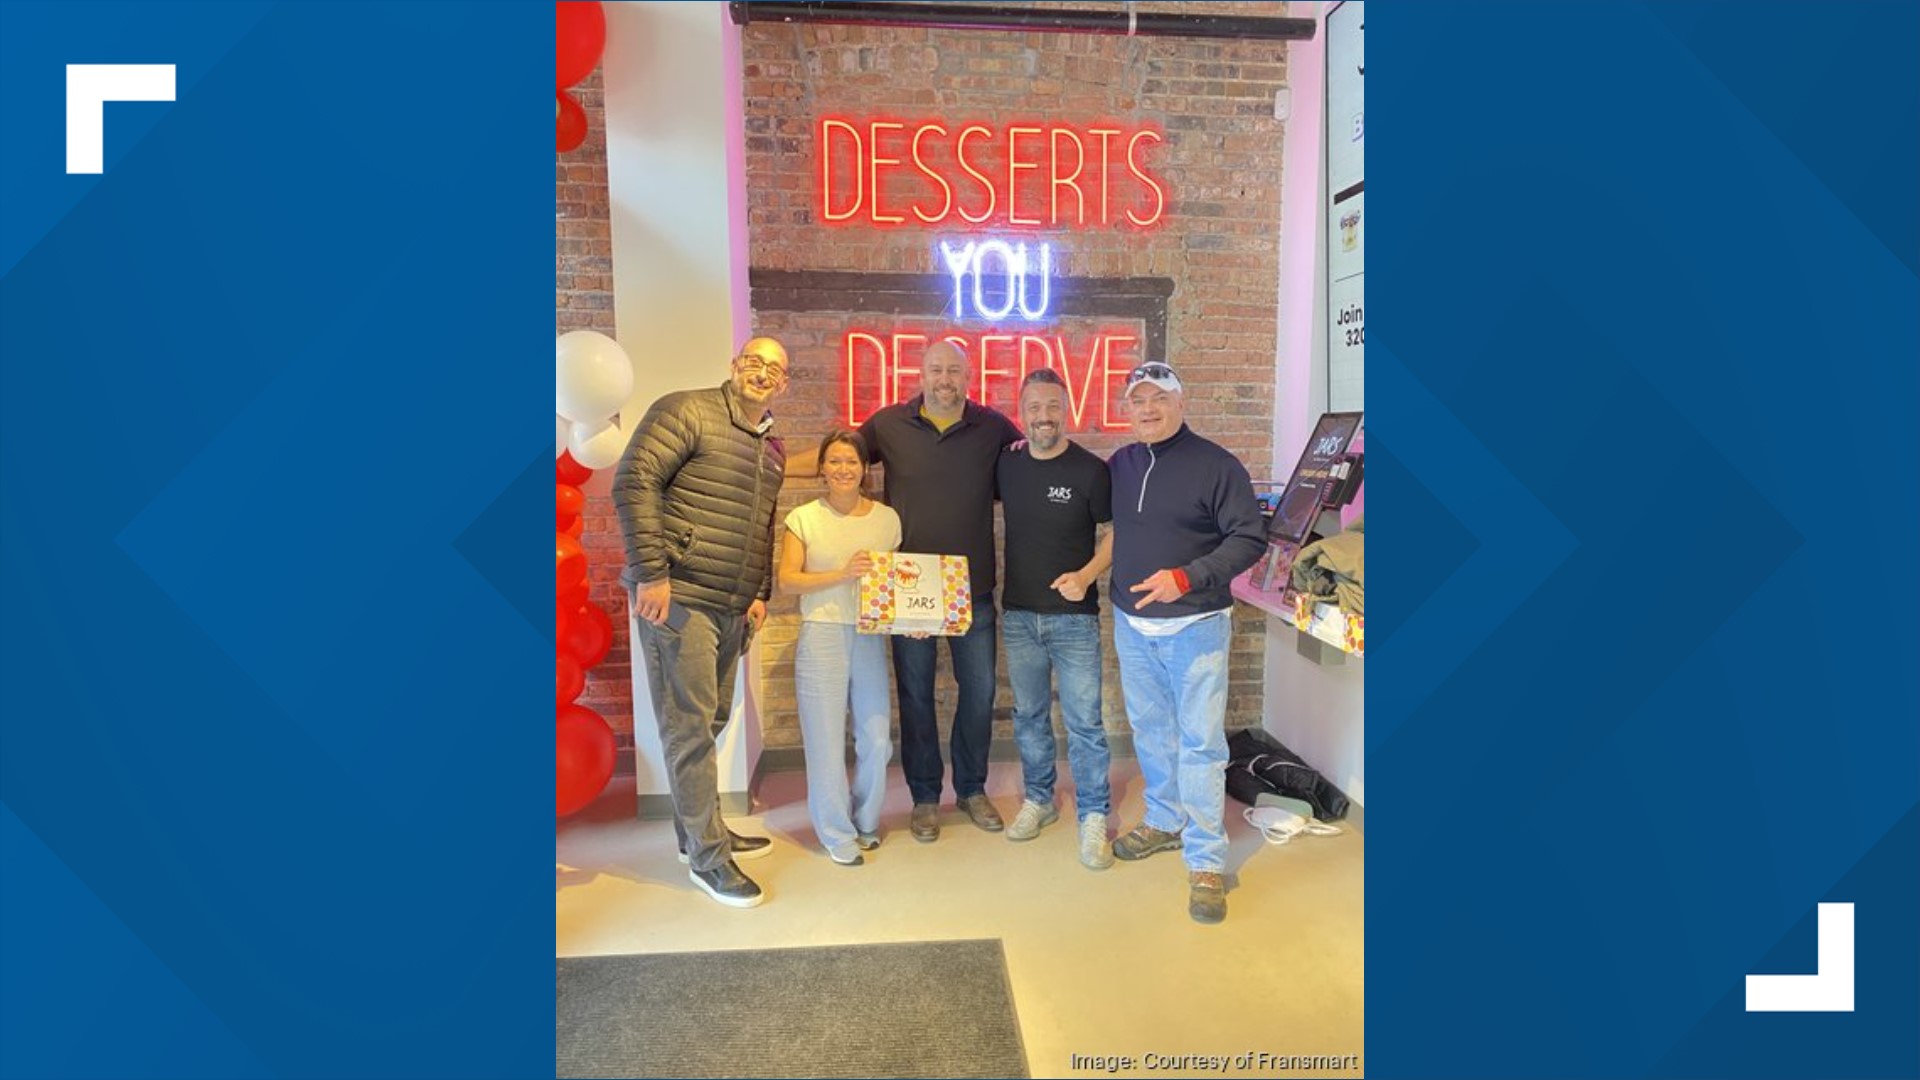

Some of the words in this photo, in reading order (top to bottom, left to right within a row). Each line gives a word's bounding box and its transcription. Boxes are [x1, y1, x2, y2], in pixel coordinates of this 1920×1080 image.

[822, 119, 1164, 227] DESSERTS
[941, 239, 1050, 321] YOU
[1337, 303, 1363, 325] Join
[847, 332, 1136, 428] DEEVE
[1047, 486, 1072, 500] JARS
[906, 596, 936, 610] JARS
